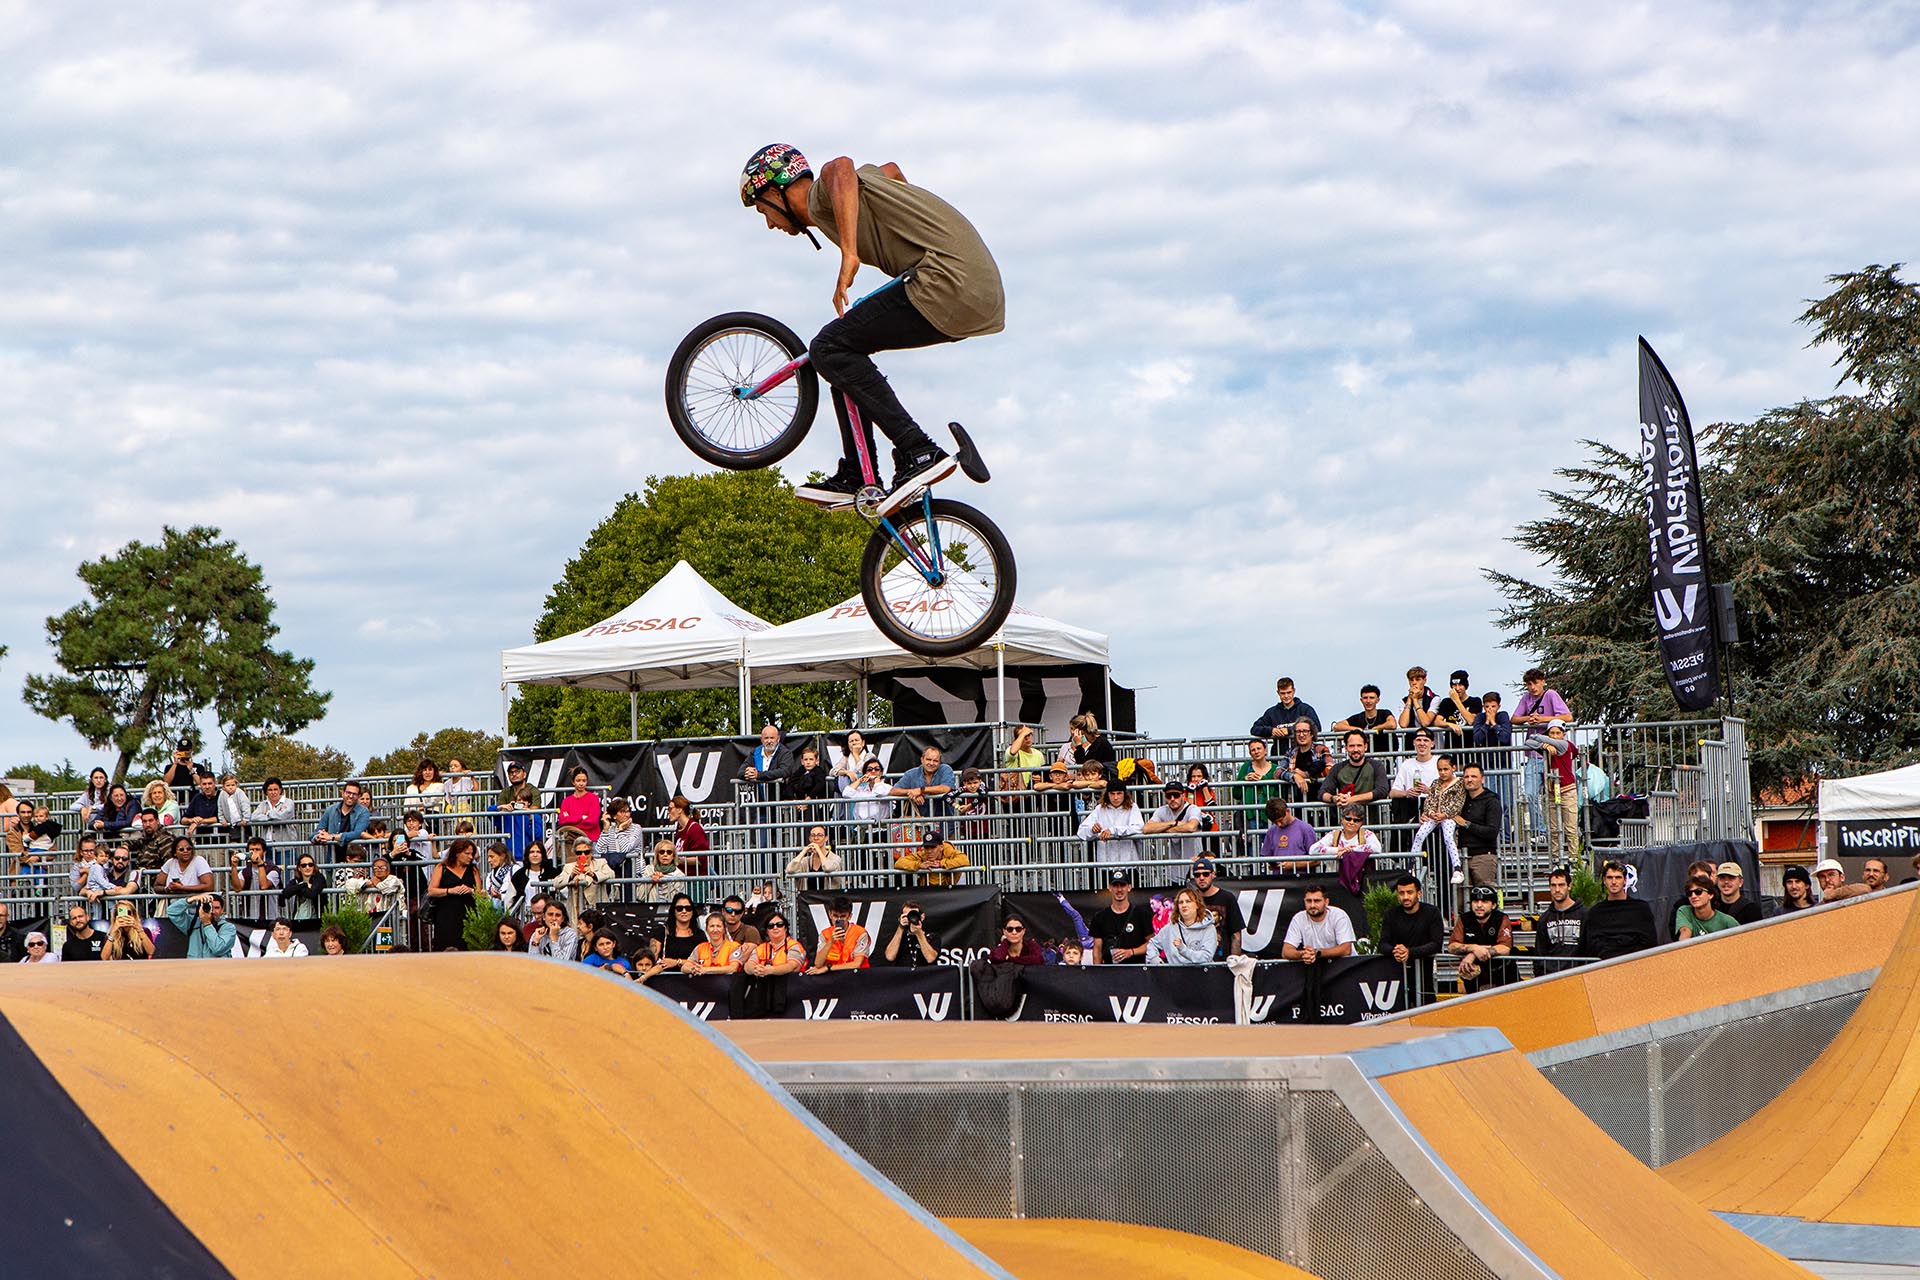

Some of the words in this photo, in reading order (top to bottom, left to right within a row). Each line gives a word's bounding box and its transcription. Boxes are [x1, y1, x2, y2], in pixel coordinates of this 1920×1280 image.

[827, 599, 954, 620] PESAC
[582, 616, 702, 637] PESSAC
[1044, 1013, 1094, 1023] PESSAC
